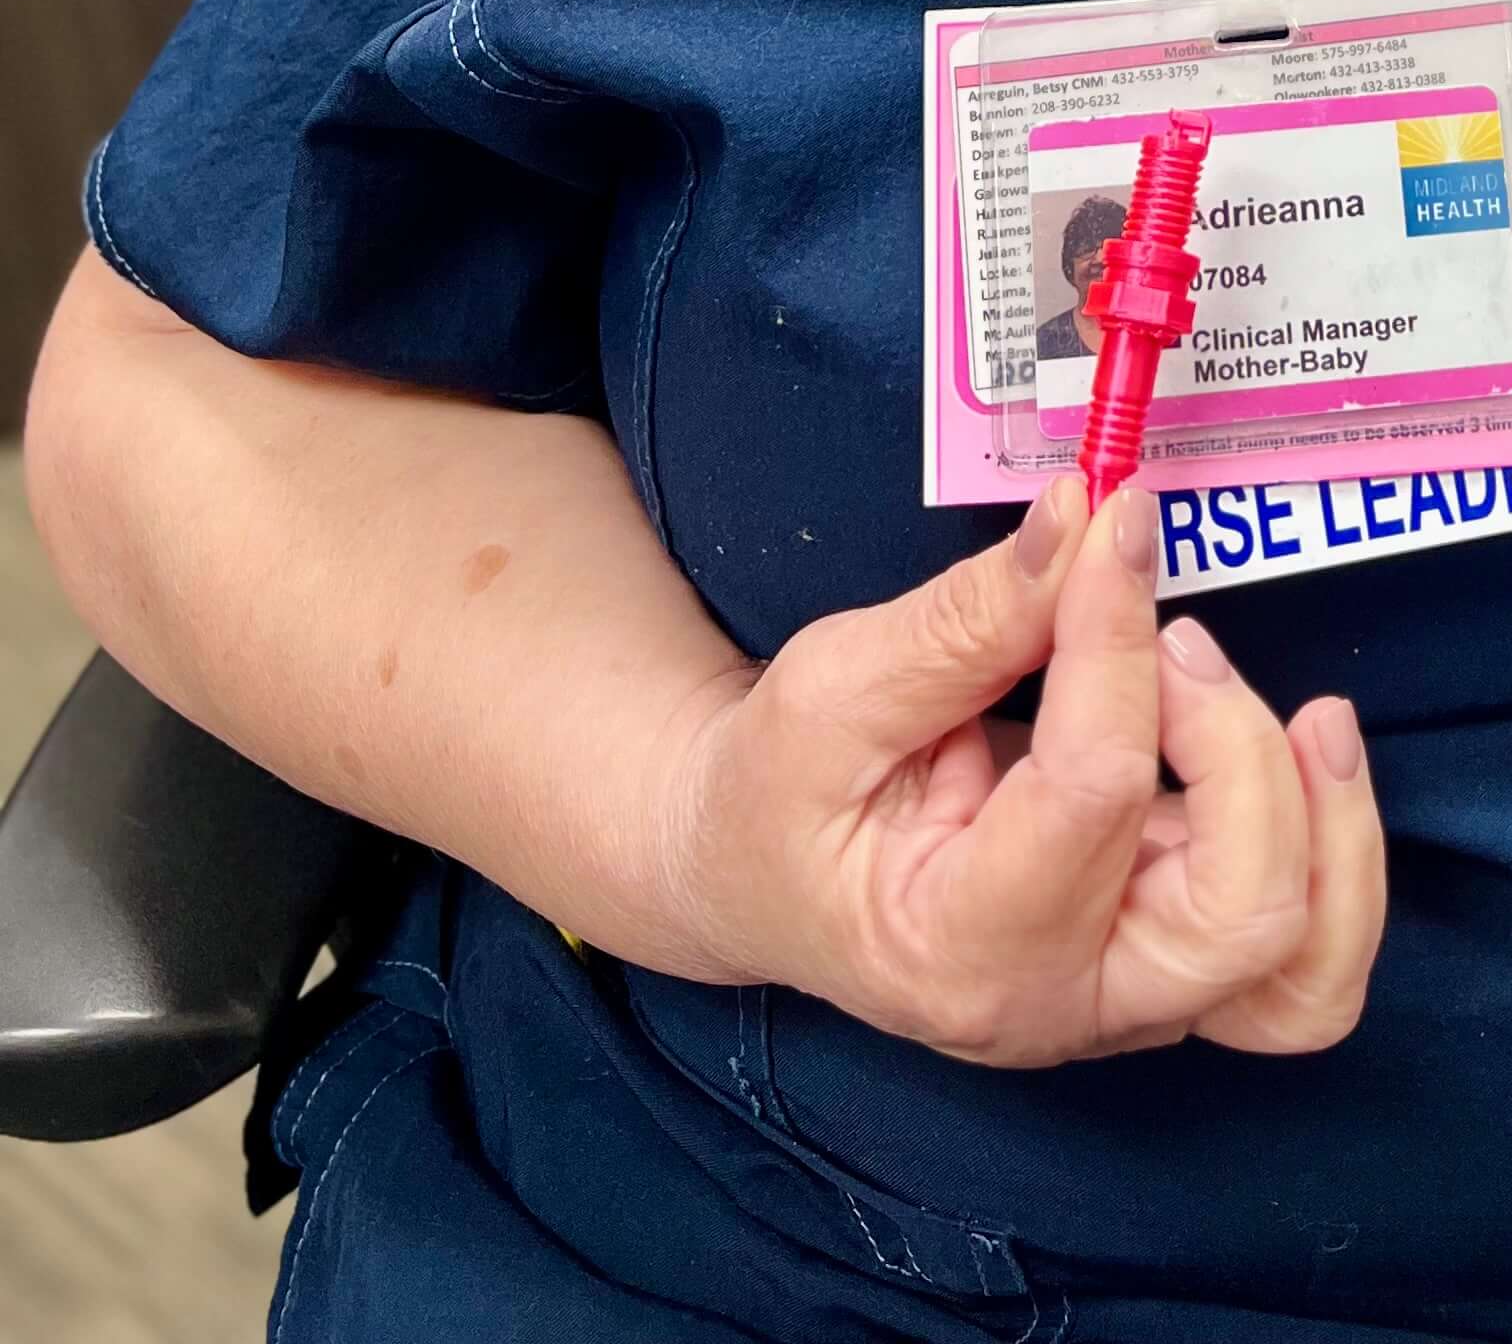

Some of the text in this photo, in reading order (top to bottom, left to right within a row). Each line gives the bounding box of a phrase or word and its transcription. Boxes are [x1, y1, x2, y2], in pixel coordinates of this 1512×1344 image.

[1271, 38, 1408, 66] Moore: 575-997-6484
[1033, 79, 1068, 96] Betsy
[1111, 63, 1199, 86] 432-553-3759
[1272, 57, 1416, 86] Morton: 432-413-3338
[1360, 71, 1446, 94] 432-813-0388
[1031, 92, 1121, 115] 208-390-6232
[1191, 194, 1365, 230] Adrieanna
[1416, 197, 1501, 223] HEALTH
[1192, 313, 1418, 353] Clinical Manager
[1194, 348, 1369, 384] Mother-Baby
[1470, 417, 1480, 434] 3
